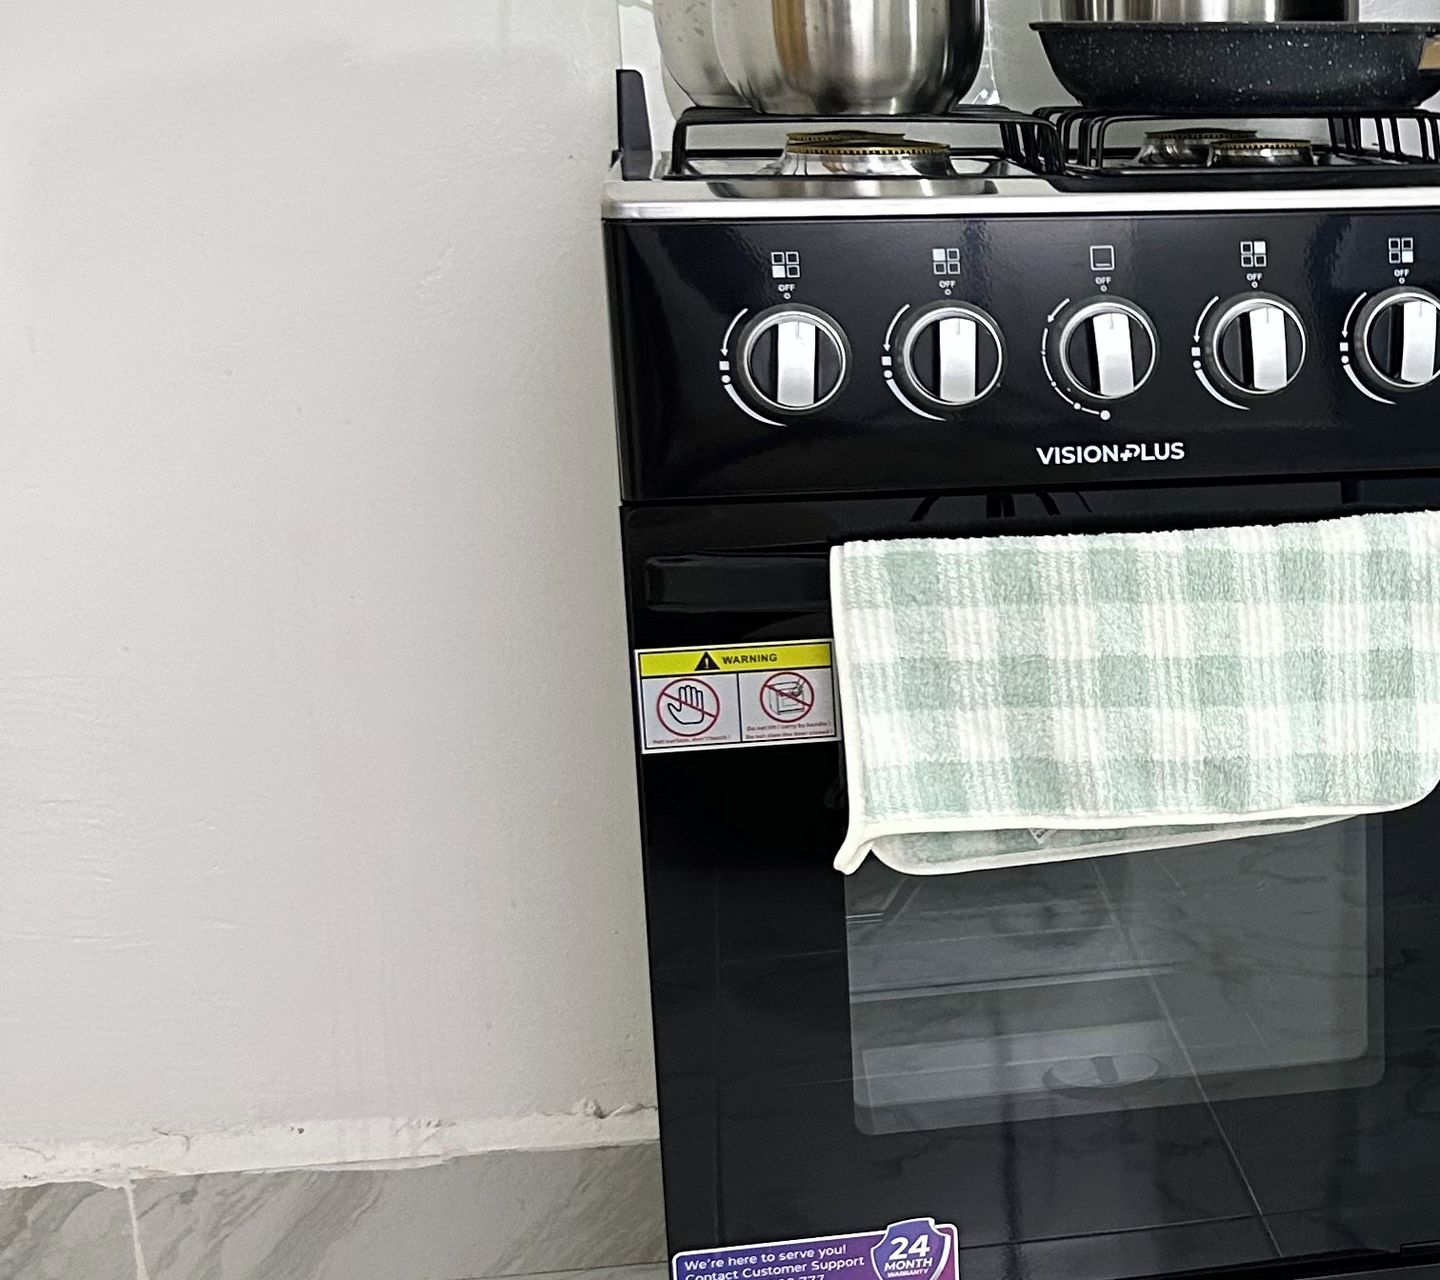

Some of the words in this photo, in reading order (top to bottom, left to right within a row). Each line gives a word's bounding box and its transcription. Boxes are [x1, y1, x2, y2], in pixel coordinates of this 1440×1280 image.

[1247, 273, 1262, 281] OFF
[1394, 269, 1409, 277] OFF
[778, 284, 795, 292] OFF
[722, 654, 778, 665] WARNING
[889, 1234, 931, 1261] 24
[684, 1256, 724, 1271] We’re
[727, 1254, 757, 1267] here
[761, 1252, 776, 1264] to
[778, 1249, 815, 1262] serve
[818, 1244, 846, 1259] you!
[742, 1264, 806, 1279] Customer
[811, 1256, 865, 1271] Support
[884, 1257, 933, 1272] MONTH
[887, 1268, 929, 1278] WARRANTY
